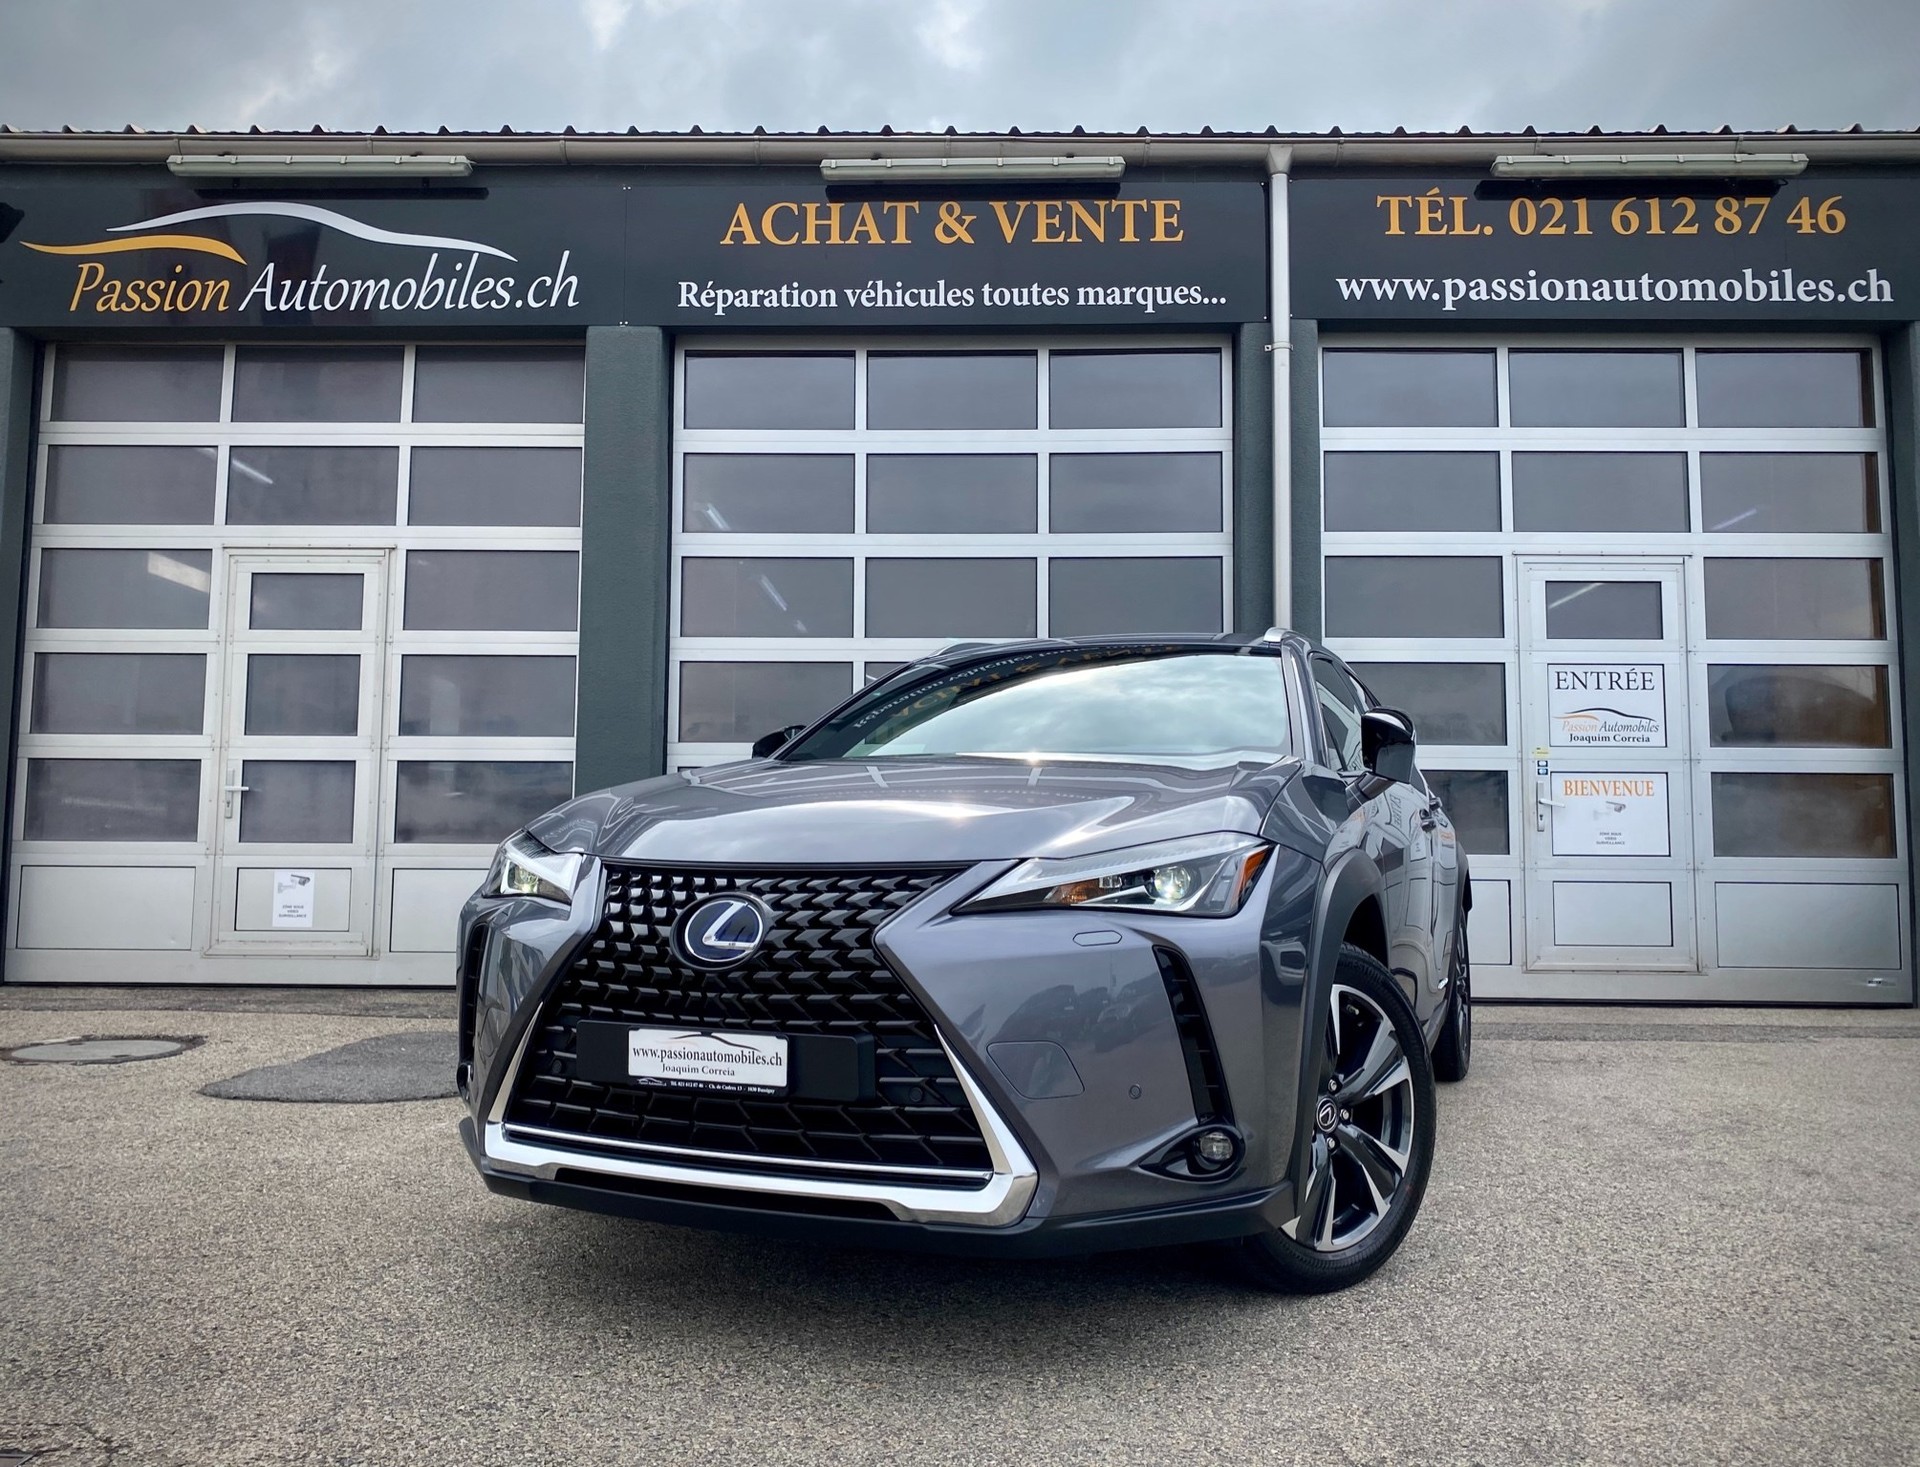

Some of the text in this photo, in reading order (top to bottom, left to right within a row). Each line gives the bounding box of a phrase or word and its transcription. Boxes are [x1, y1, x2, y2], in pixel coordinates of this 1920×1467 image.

[720, 200, 1185, 246] ACHAT & VENTE
[1376, 187, 1847, 236] TÉL. 021 612 87 46
[68, 250, 580, 313] Passion Automobiles.ch
[1335, 268, 1894, 311] www.passionautomobiles.ch
[678, 280, 1227, 316] Réparation véhicules toutes marques...
[1555, 668, 1655, 691] ENTRÉE
[1562, 719, 1660, 734] Passion Automobiles
[1569, 733, 1651, 744] Joaquim Correia
[1563, 780, 1655, 797] BIENVENUE
[633, 1047, 783, 1067] www.passionautomobiles.ch
[662, 1063, 735, 1077] Joaquim Correia
